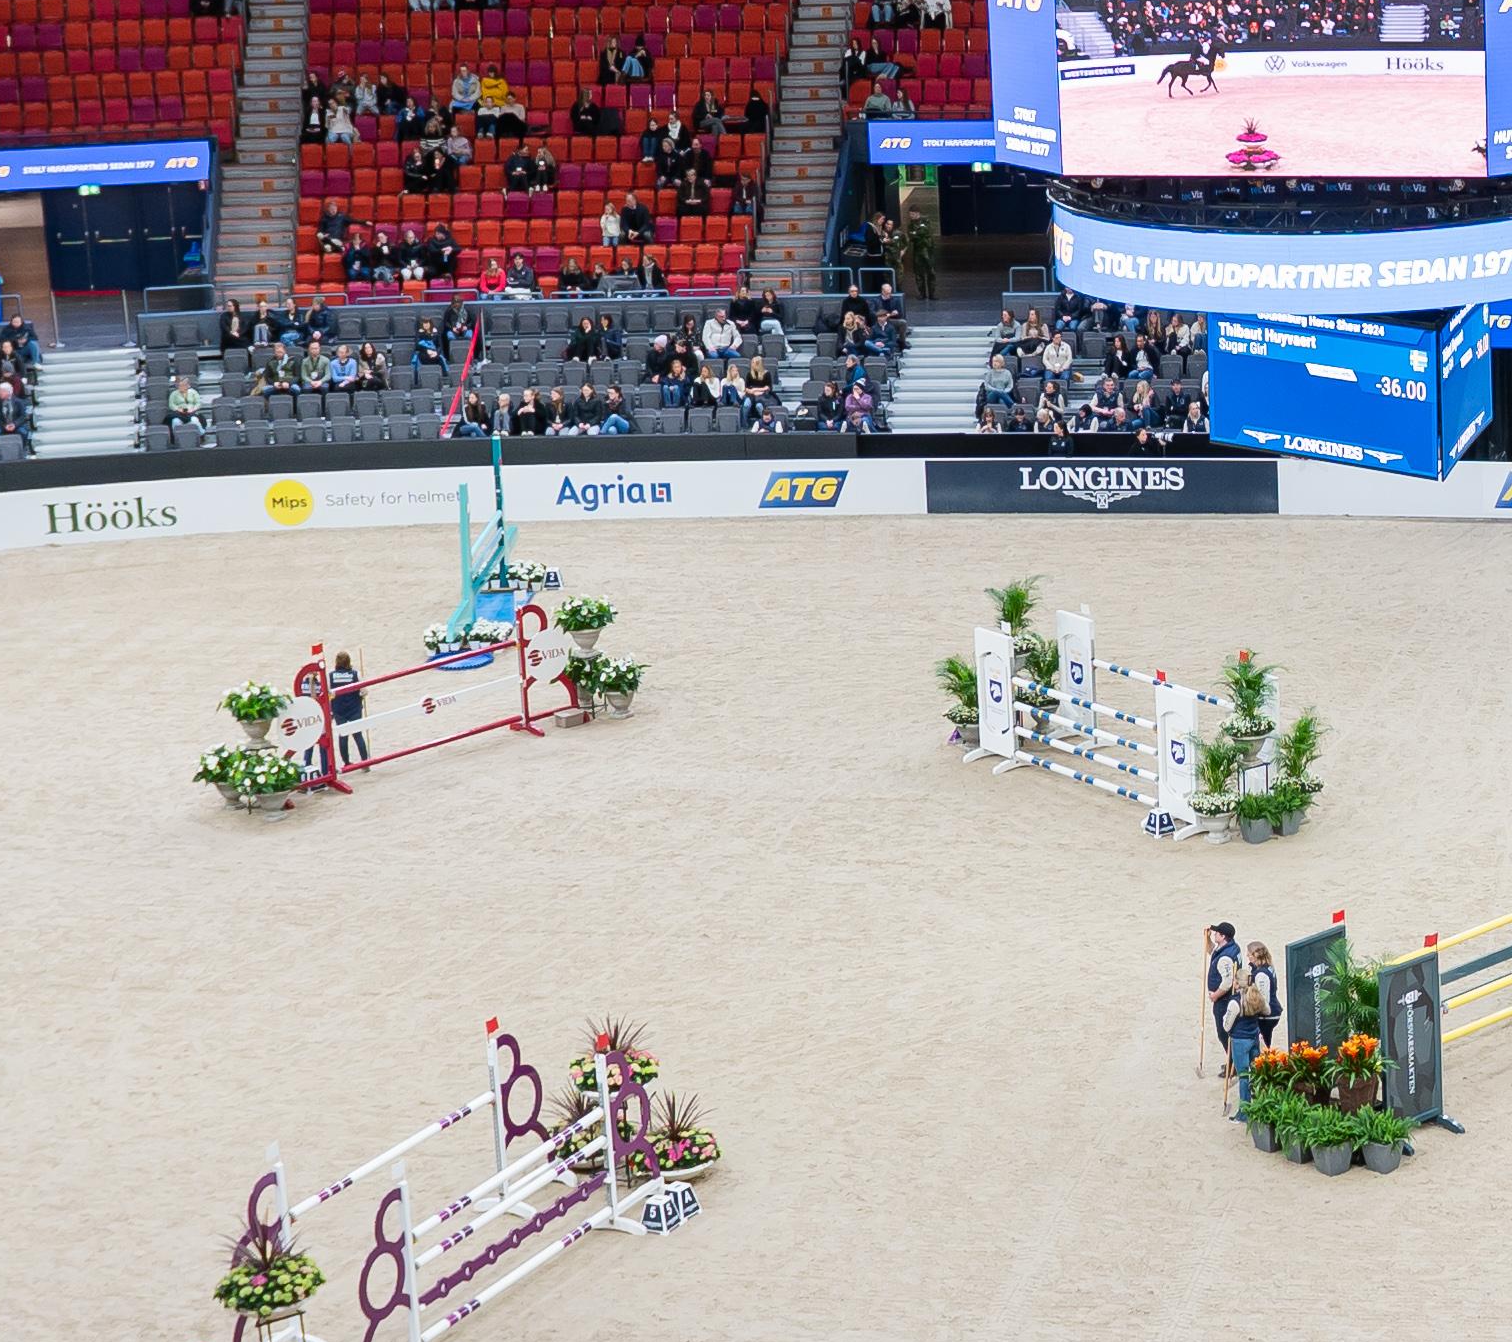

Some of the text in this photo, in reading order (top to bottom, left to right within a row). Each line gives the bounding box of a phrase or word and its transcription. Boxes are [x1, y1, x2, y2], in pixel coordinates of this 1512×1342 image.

[1292, 60, 1347, 69] Volkswagen
[1387, 57, 1444, 71] Hööks
[880, 137, 911, 149] ATG
[922, 139, 945, 147] STOLT
[136, 160, 155, 170] 1977
[1054, 225, 1075, 266] TG
[1092, 247, 1151, 281] STOLT
[1153, 258, 1374, 290] HUVUDPARTNER
[1377, 255, 1470, 287] SEDAN
[1308, 315, 1336, 330] Horse
[1336, 318, 1360, 333] Show
[1362, 322, 1385, 337] 2024
[1489, 314, 1512, 329] TG
[1218, 321, 1262, 341] Thibaut
[1218, 338, 1268, 355] Sugar Girl
[1375, 376, 1427, 402] -36.00
[1283, 435, 1364, 461] LONGINES
[1019, 466, 1185, 492] LONGINES
[556, 473, 647, 512] Agria
[765, 477, 842, 503] ATG
[272, 490, 462, 509] Mips Safety for helmet
[43, 496, 178, 535] Hööks
[549, 572, 556, 581] 2
[541, 646, 567, 662] VIDA
[436, 694, 458, 708] VIDA
[297, 714, 323, 729] VIDA
[1161, 814, 1168, 825] 3
[1405, 1002, 1417, 1096] FÖRSVARSMAKTEN
[684, 1191, 693, 1204] A
[649, 1205, 657, 1219] 5
[666, 1202, 673, 1216] 5
